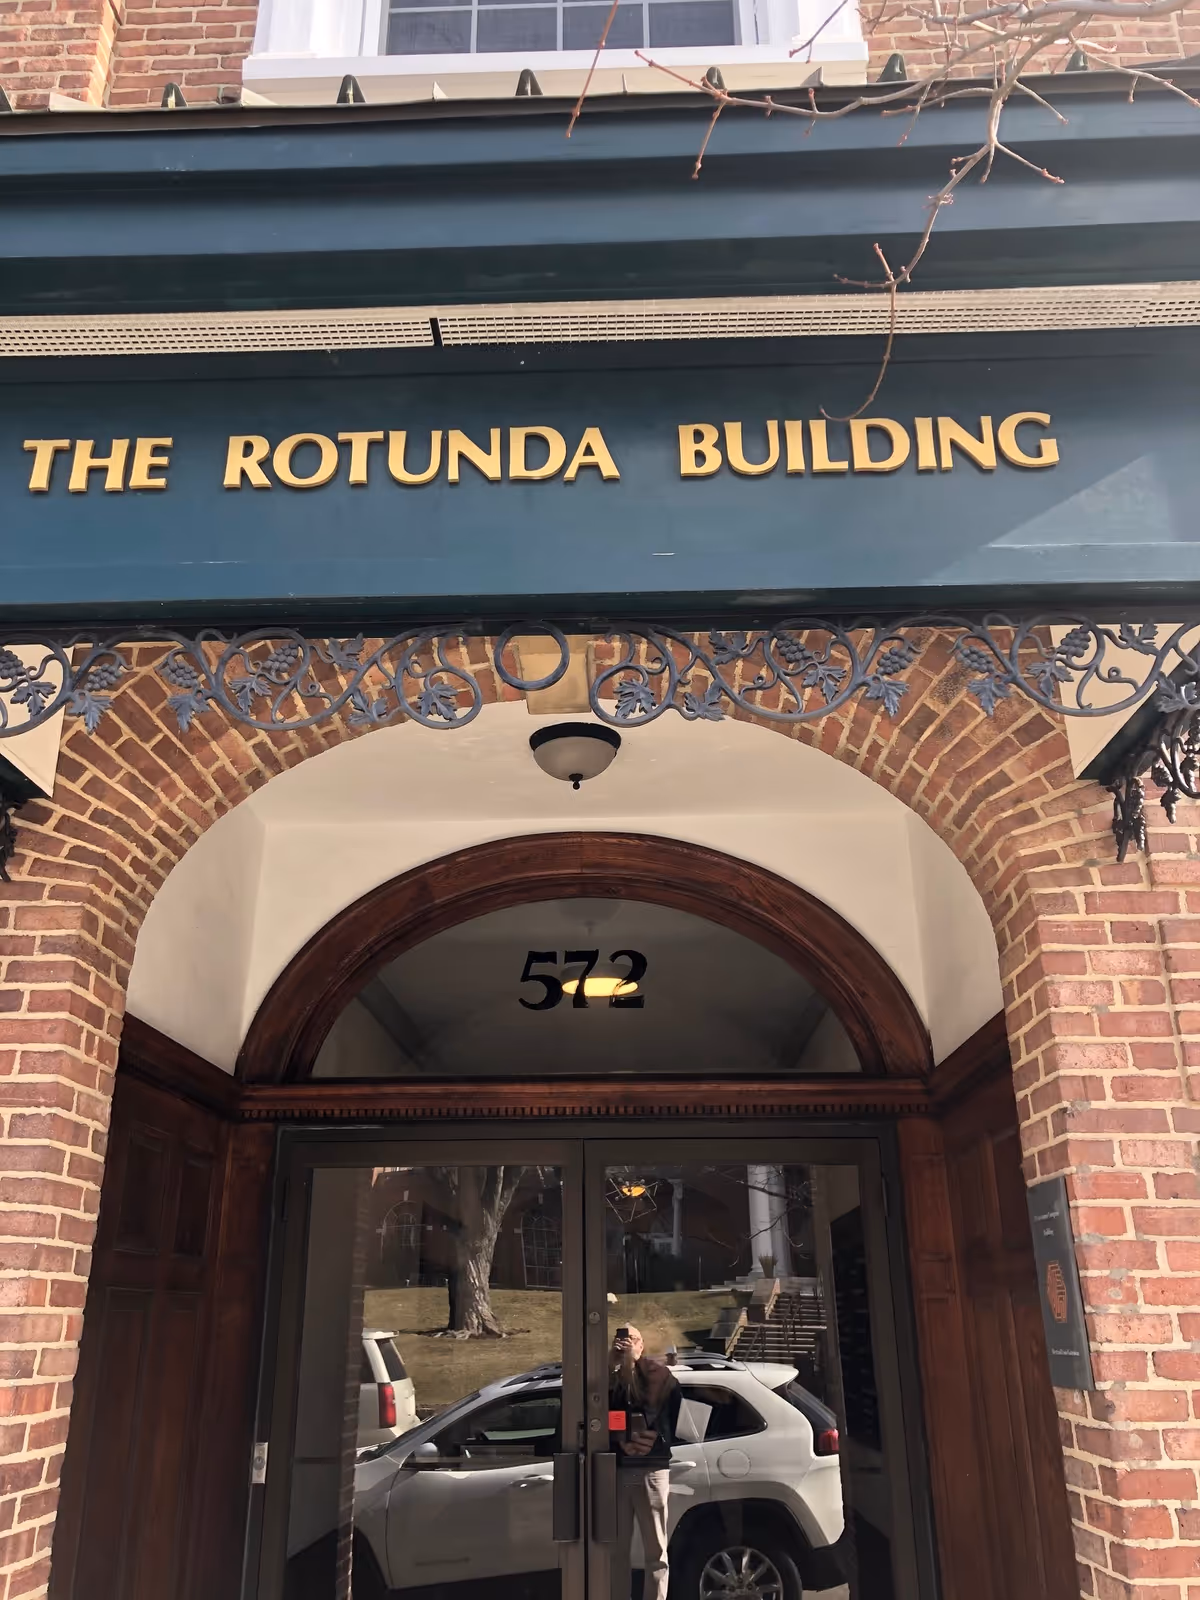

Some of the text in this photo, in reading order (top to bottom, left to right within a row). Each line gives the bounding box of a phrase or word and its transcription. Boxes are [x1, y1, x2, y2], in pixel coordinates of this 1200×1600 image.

[22, 411, 1061, 493] THE ROTUNDA BUILDING
[518, 949, 648, 1010] 572
